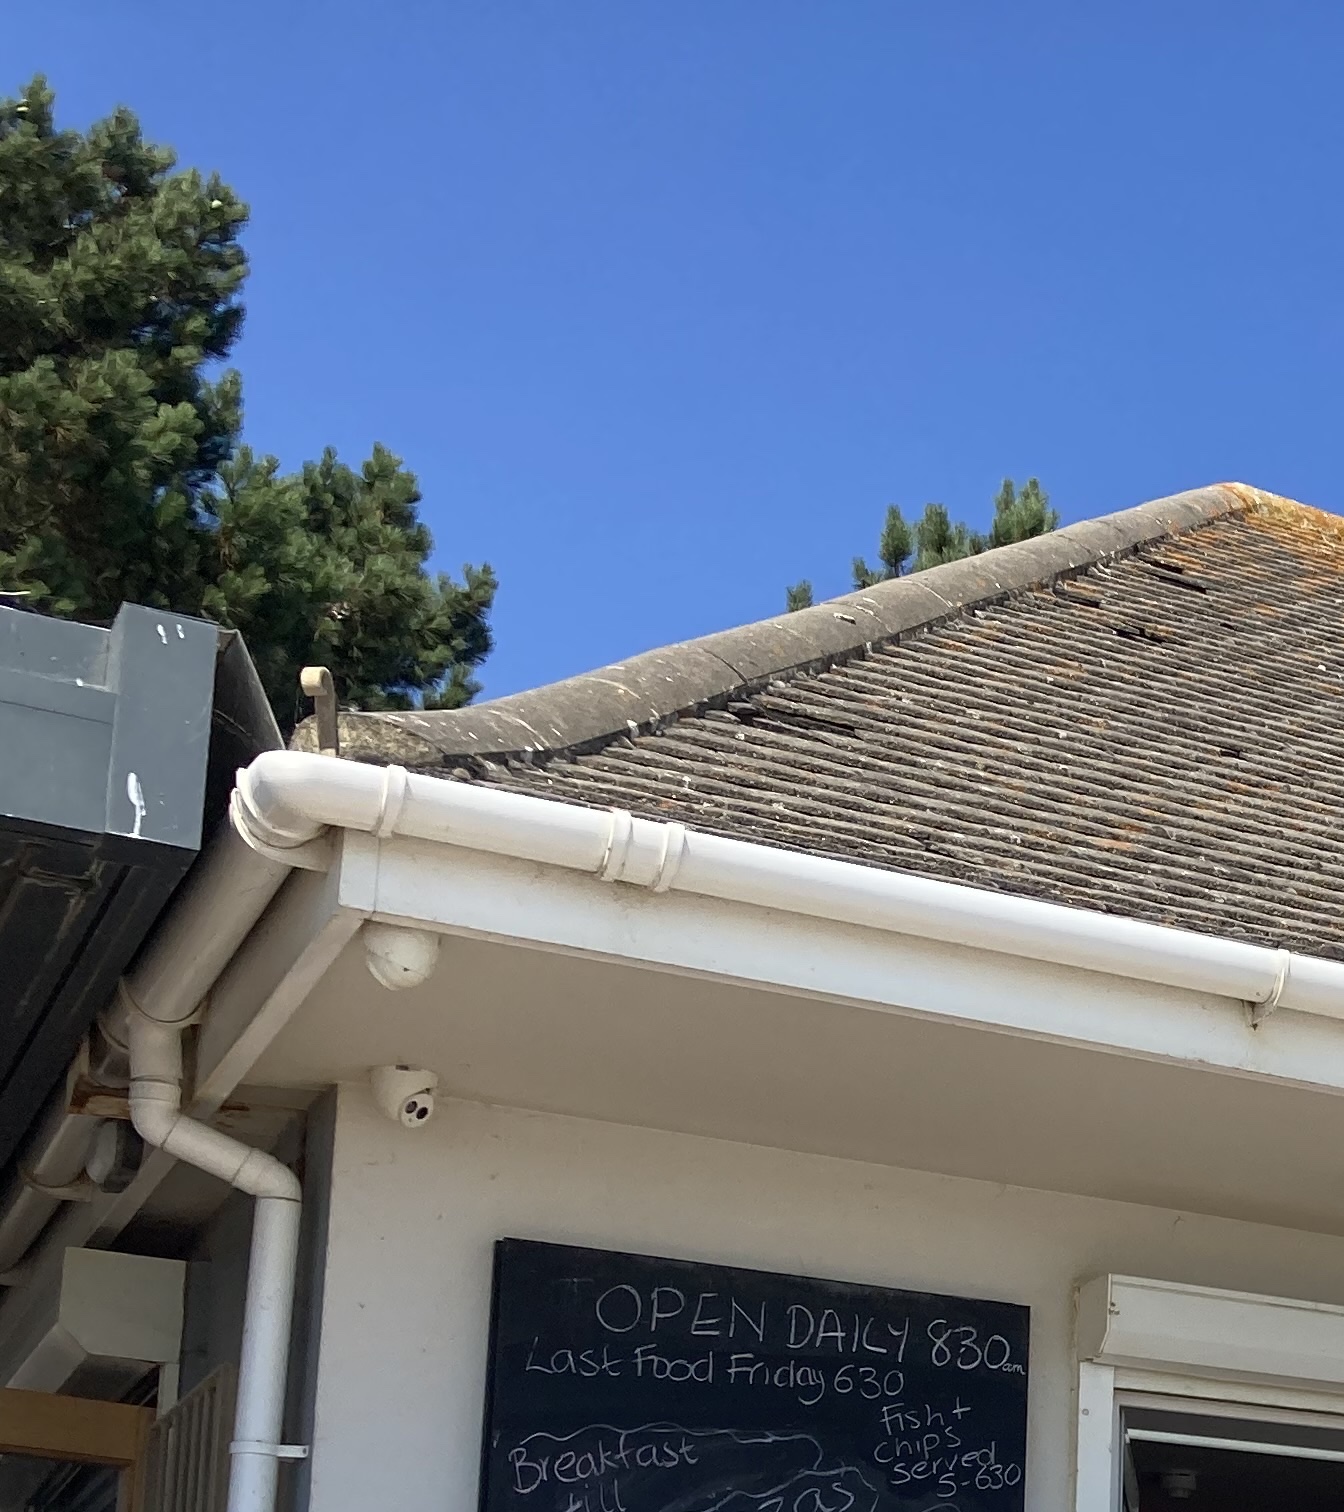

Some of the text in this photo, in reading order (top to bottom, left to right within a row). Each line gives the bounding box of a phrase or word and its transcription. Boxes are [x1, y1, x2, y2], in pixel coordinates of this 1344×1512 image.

[596, 1284, 766, 1342] OPEN
[786, 1304, 911, 1363] DAILY
[525, 1336, 905, 1405] Last Food Friday 630
[874, 1425, 962, 1464] chips
[880, 1402, 946, 1436] Fish
[508, 1430, 700, 1494] Breakfast
[891, 1441, 998, 1485] served
